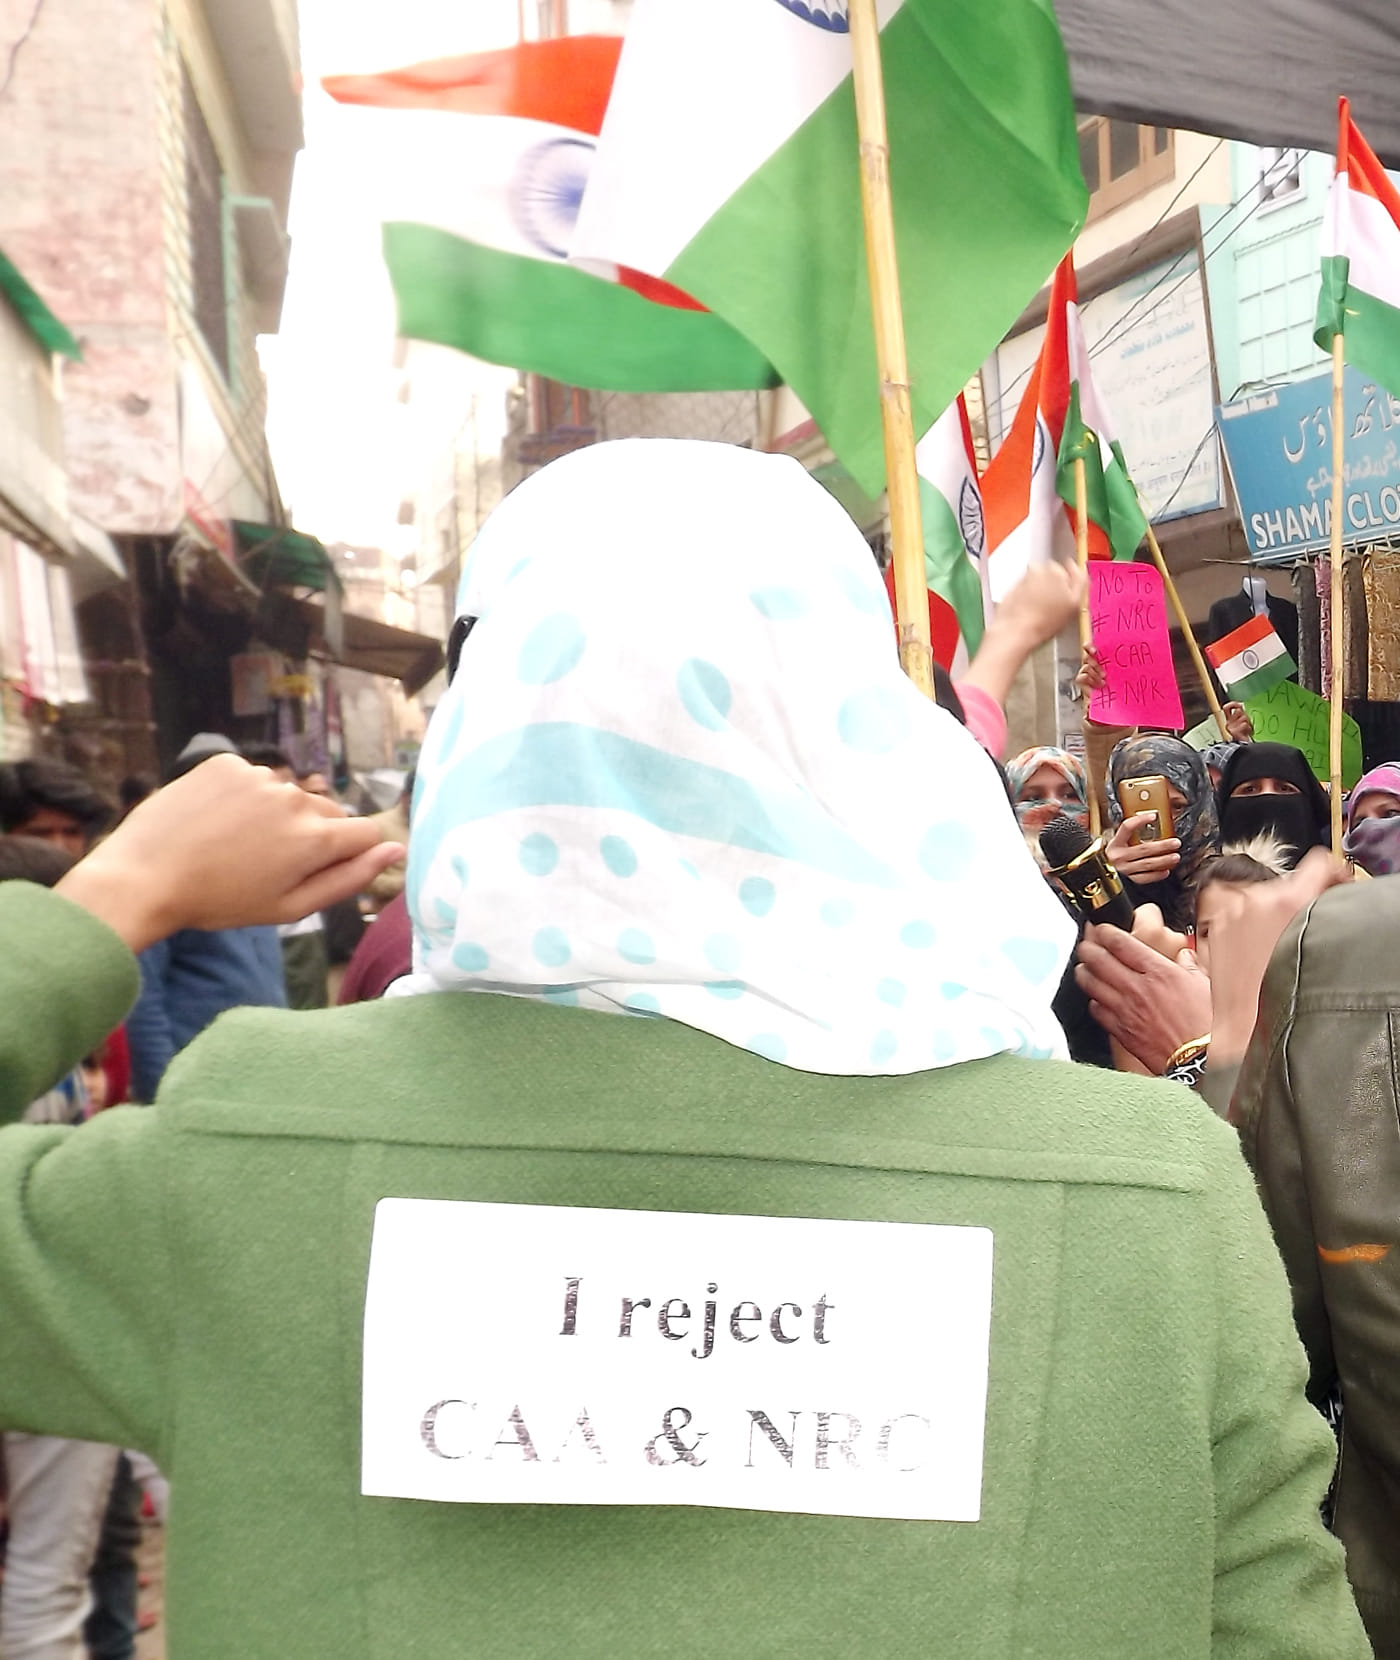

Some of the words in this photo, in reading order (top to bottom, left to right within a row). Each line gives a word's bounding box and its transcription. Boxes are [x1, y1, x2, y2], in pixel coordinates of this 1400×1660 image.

[558, 1276, 584, 1337] I
[617, 1281, 836, 1360] reject
[419, 1399, 608, 1465] CAA
[643, 1406, 710, 1468] &
[743, 1409, 932, 1473] NRC
